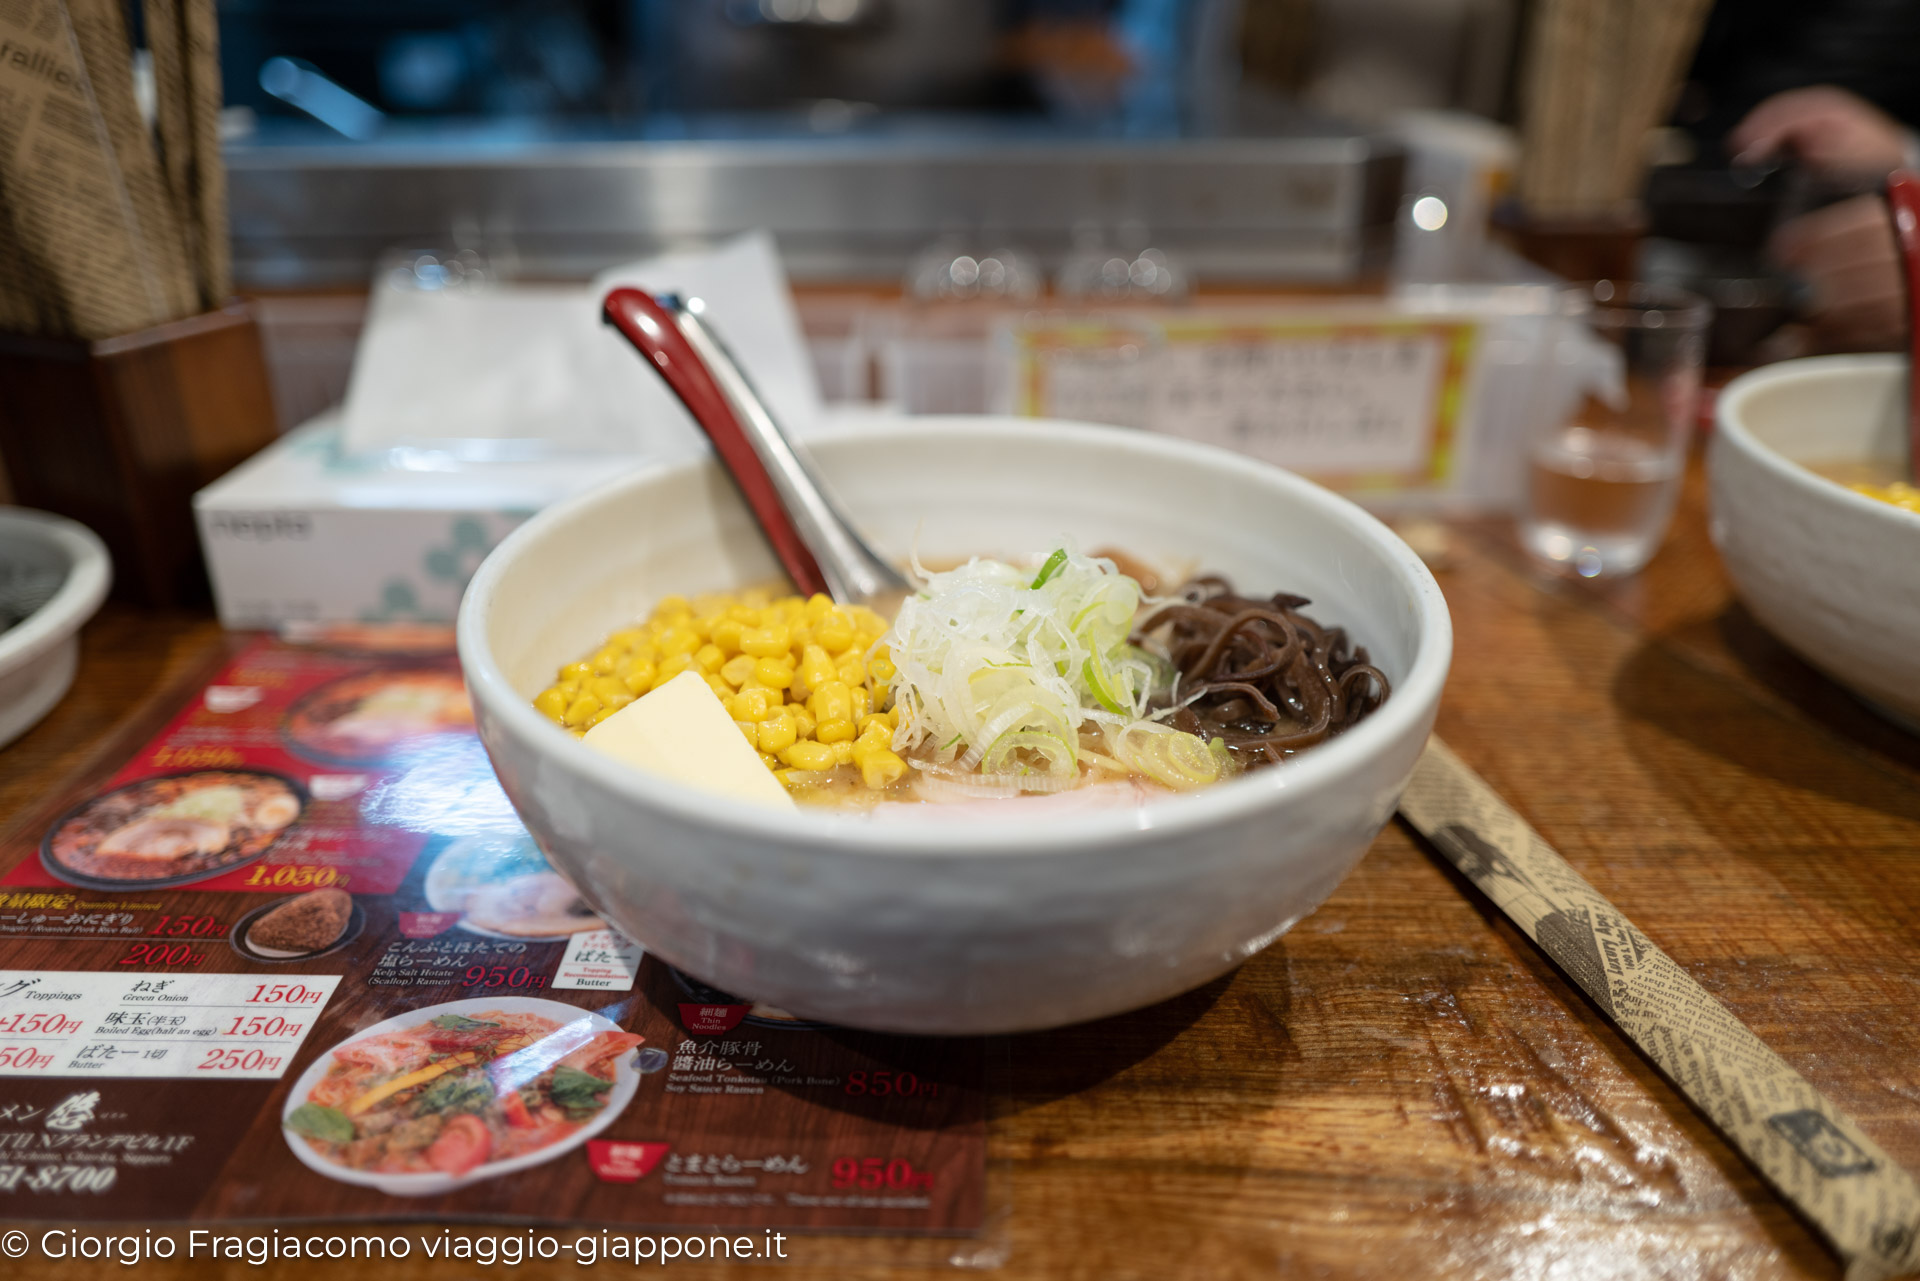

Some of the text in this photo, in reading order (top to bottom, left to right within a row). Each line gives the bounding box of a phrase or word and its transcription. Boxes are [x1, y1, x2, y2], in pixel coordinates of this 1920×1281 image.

[147, 915, 229, 937] 150円
[119, 944, 206, 967] 200円
[378, 954, 469, 968] 塩らーめん
[575, 950, 631, 963] ばたー
[372, 968, 454, 978] Kelp Salt Hotate
[462, 965, 547, 988] 950円
[131, 979, 175, 993] ねぎ
[367, 977, 451, 986] (Scallop) Ramen
[576, 978, 611, 987] Butter
[25, 990, 83, 1001] Toppings
[122, 993, 189, 1002] Green Onion
[245, 984, 323, 1004] 150円
[94, 1026, 129, 1035] Boiled
[177, 1028, 190, 1036] an
[222, 1016, 303, 1037] 150円
[675, 1039, 762, 1056] 魚介豚骨
[68, 1060, 104, 1070] Butter
[197, 1048, 282, 1071] 250円
[668, 1073, 713, 1083] Seafood
[845, 1070, 938, 1098] 850円
[665, 1083, 764, 1095] Soy Sauce Ramen
[831, 1156, 935, 1190] 950円
